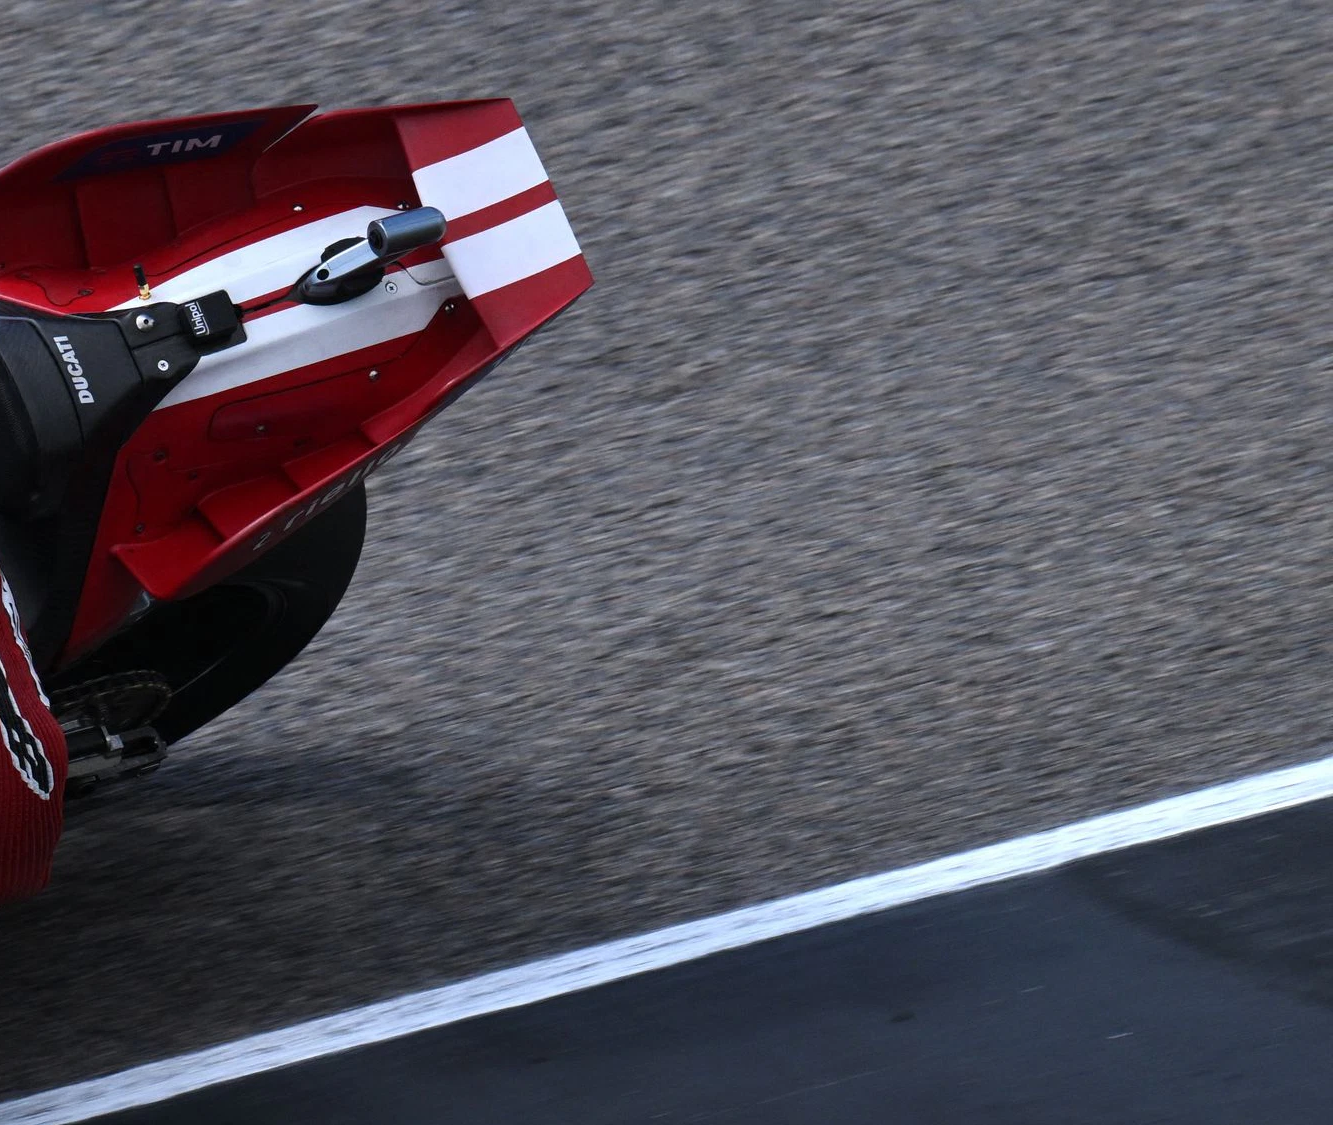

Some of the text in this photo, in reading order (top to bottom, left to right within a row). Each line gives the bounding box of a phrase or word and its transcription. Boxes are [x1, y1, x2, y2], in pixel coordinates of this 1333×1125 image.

[146, 134, 222, 157] TIM
[184, 301, 205, 335] Unipol
[53, 335, 95, 404] DUCATI
